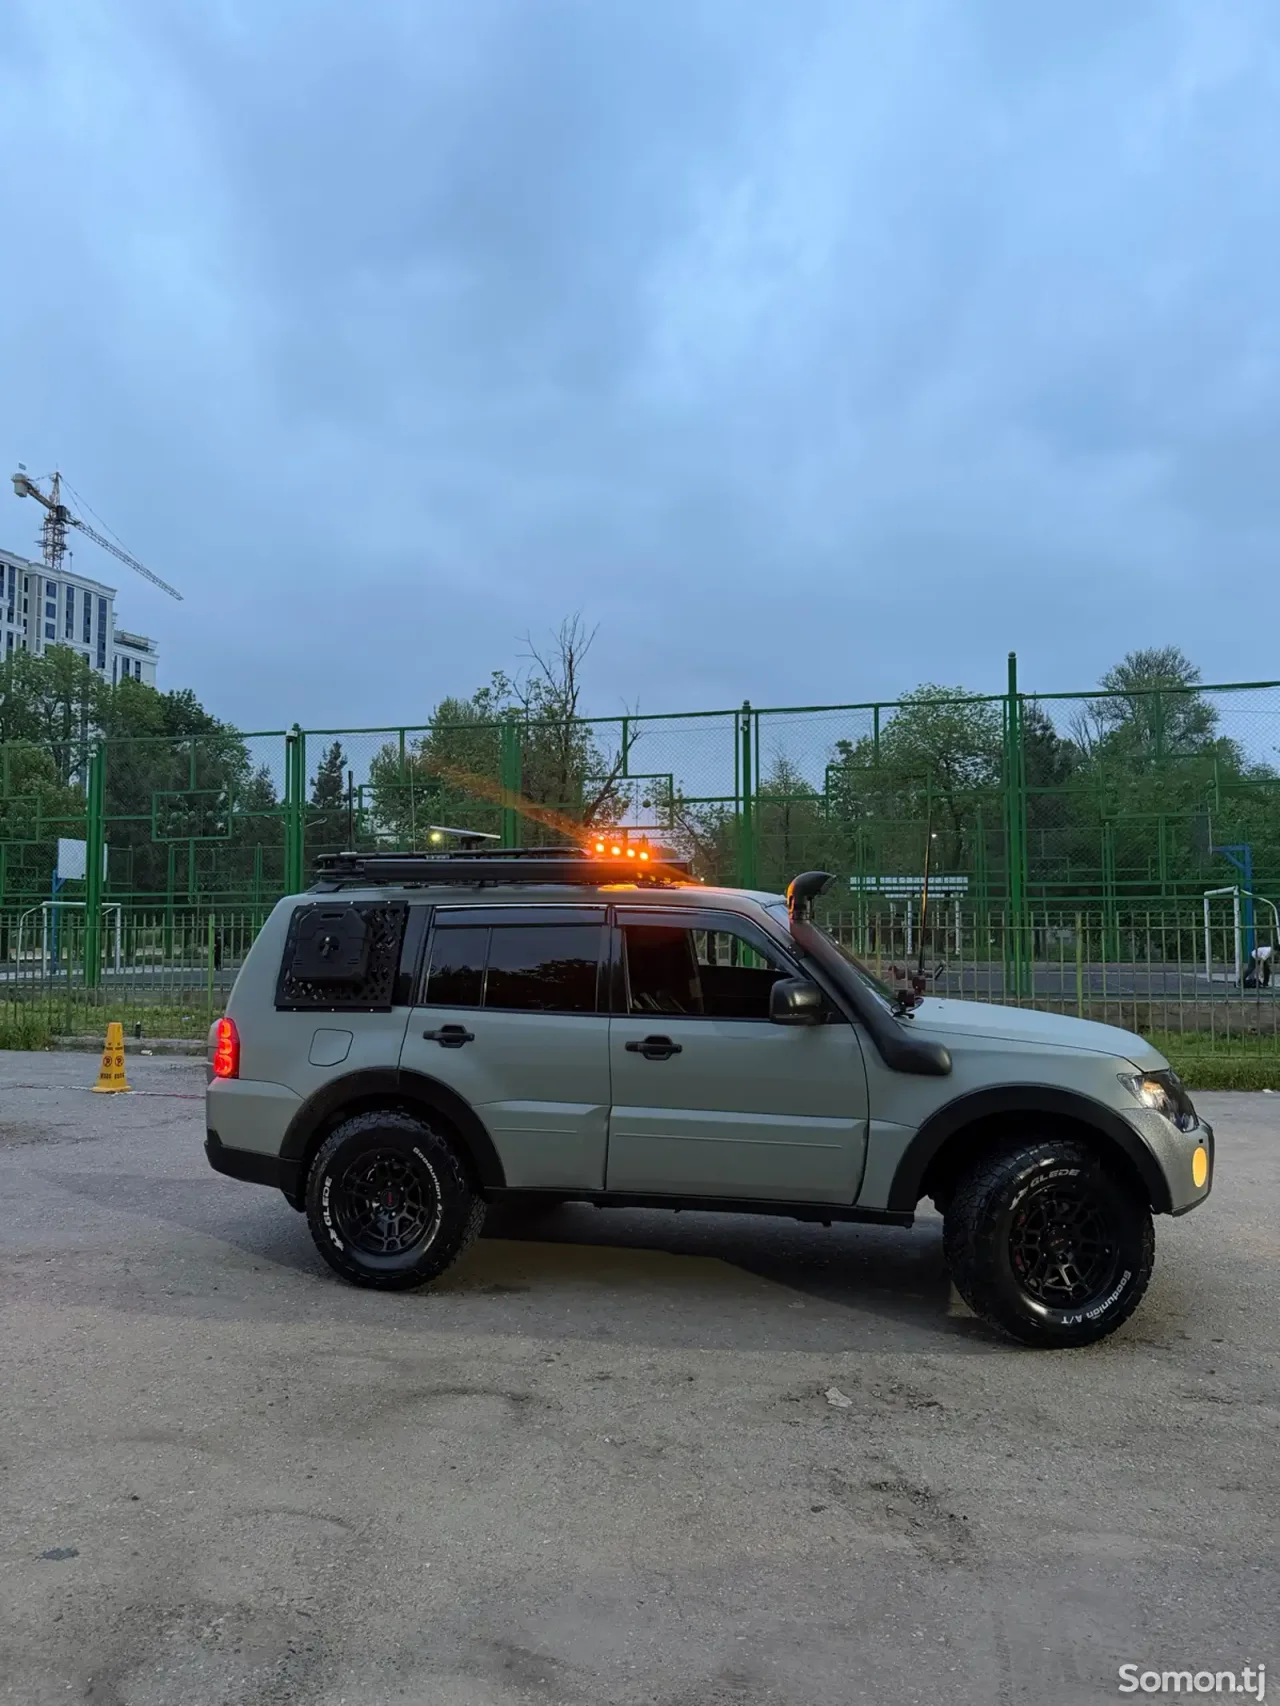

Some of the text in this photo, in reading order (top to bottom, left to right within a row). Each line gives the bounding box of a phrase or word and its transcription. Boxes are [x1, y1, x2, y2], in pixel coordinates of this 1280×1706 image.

[322, 1176, 333, 1225] GLEDE
[1030, 1169, 1080, 1187] GLEDE
[1061, 1271, 1132, 1324] Goodunion A/T
